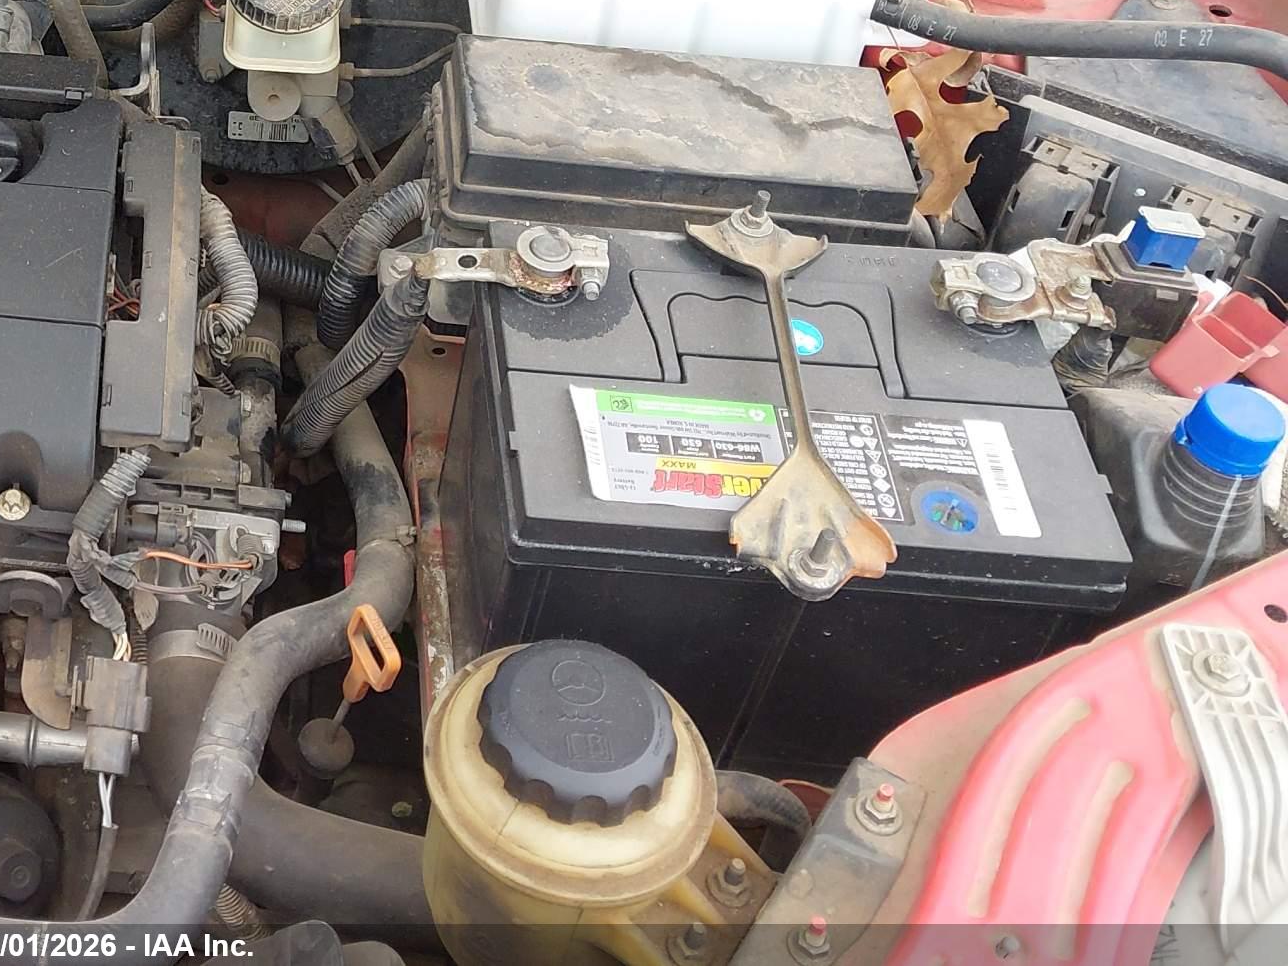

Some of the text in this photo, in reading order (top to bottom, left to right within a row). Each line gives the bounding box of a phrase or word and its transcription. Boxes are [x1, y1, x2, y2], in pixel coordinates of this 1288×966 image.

[926, 20, 937, 36] E
[943, 25, 958, 42] 27
[1179, 29, 1188, 47] E
[1199, 29, 1214, 47] 27
[638, 435, 659, 445] 100
[681, 437, 703, 448] 630
[715, 441, 761, 453] W86-630
[661, 459, 697, 470] MAXX
[653, 470, 766, 498] verStart
